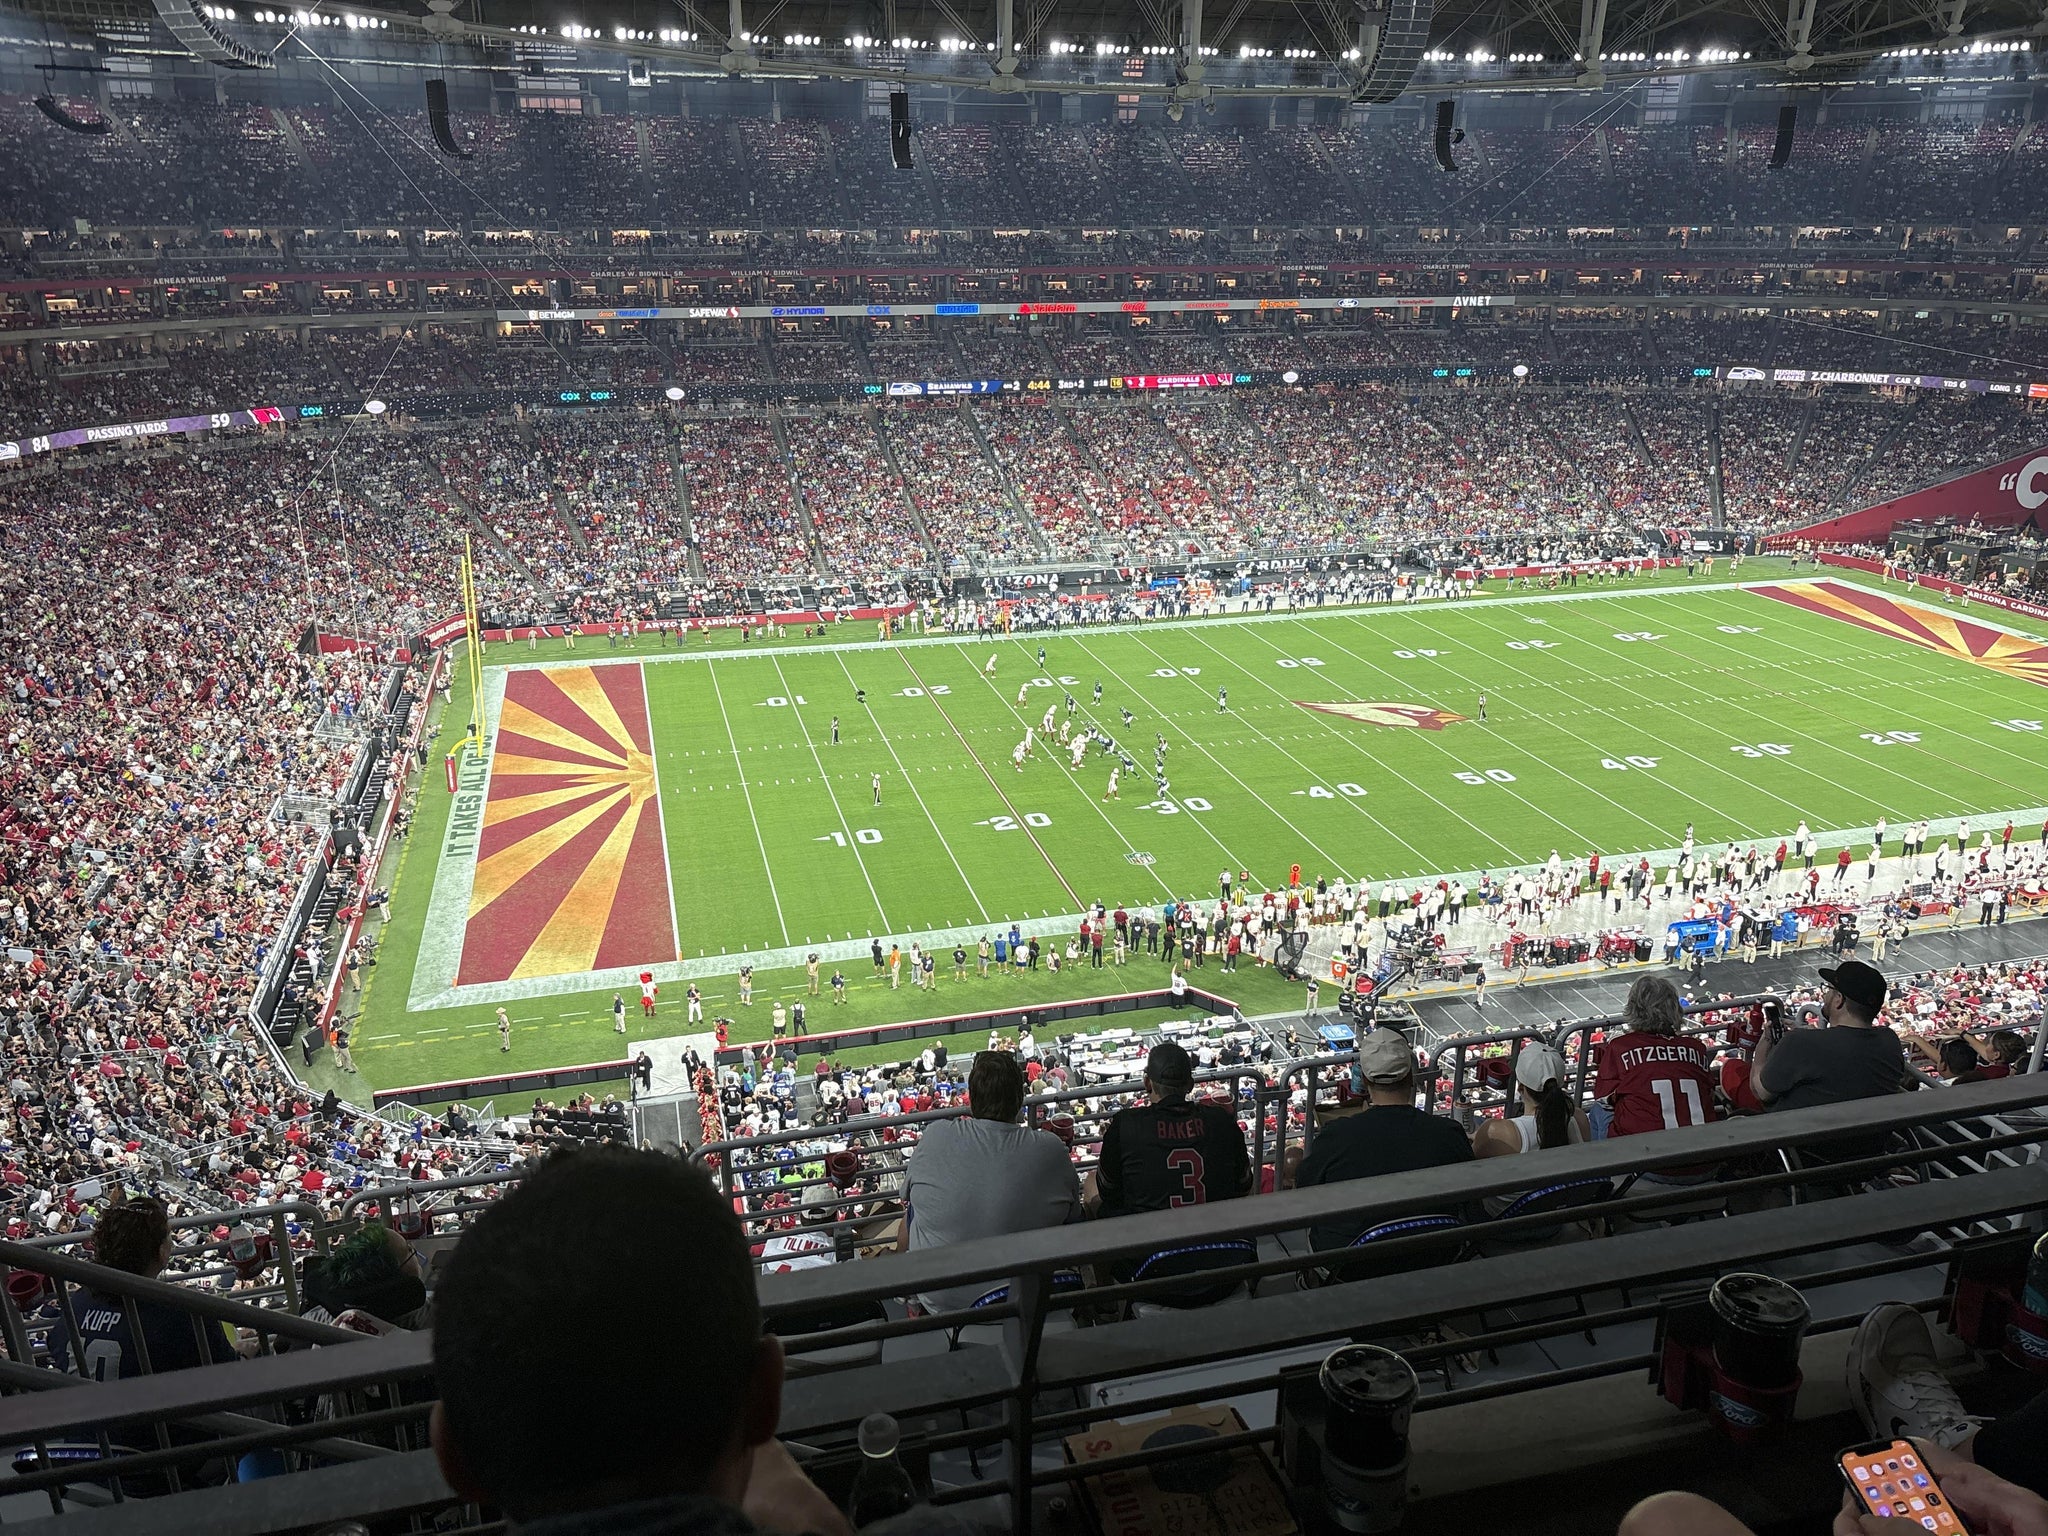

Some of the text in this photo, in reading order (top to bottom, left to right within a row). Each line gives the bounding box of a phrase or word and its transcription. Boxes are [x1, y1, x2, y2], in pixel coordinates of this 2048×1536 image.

[153, 277, 186, 285] AENEAS
[187, 275, 227, 284] WILLIAMS
[1452, 296, 1491, 306] AVNET
[689, 308, 728, 318] SAFEWAY
[867, 305, 890, 314] COX
[539, 311, 575, 319] BETMGM
[1432, 369, 1448, 377] COX
[1456, 368, 1472, 376] COX
[1693, 368, 1712, 376] COX
[1138, 377, 1146, 388] 3
[1235, 375, 1252, 383] COX
[1811, 372, 1890, 384] Z.CHARBONNET
[1913, 376, 1921, 385] 4
[864, 385, 882, 394] COX
[927, 382, 988, 392] SEAHAWKS 7
[1013, 381, 1020, 391] 2
[1027, 380, 1051, 390] 4:44
[1943, 380, 1967, 389] YDS 6
[1990, 384, 2010, 392] LONG
[2014, 385, 2022, 394] 5
[560, 392, 581, 401] COX
[590, 391, 610, 400] COX
[301, 406, 323, 416] COX
[32, 413, 230, 453] 84 PASSING YARDS 59
[1968, 590, 2007, 606] ARIZONA
[644, 621, 694, 629] ARIZOA
[1989, 719, 2044, 733] 10
[1859, 731, 1922, 746] 20
[1730, 743, 1791, 758] 30
[1600, 755, 1657, 771] 40
[461, 768, 487, 792] ALL
[1451, 769, 1516, 785] 50
[1308, 783, 1368, 799] 40
[1150, 797, 1213, 814] 30
[450, 794, 482, 840] TAKES
[989, 812, 1053, 831] 20
[829, 828, 883, 847] 10
[446, 843, 474, 857] IT
[1333, 963, 1343, 973] G
[1620, 1045, 1710, 1073] FITZGERALD
[869, 1099, 880, 1107] 85
[1651, 1078, 1706, 1130] 11
[1157, 1118, 1205, 1140] BAKER
[1166, 1148, 1206, 1209] 3
[80, 1309, 122, 1333] KUPP
[1717, 1398, 1761, 1428] Ford
